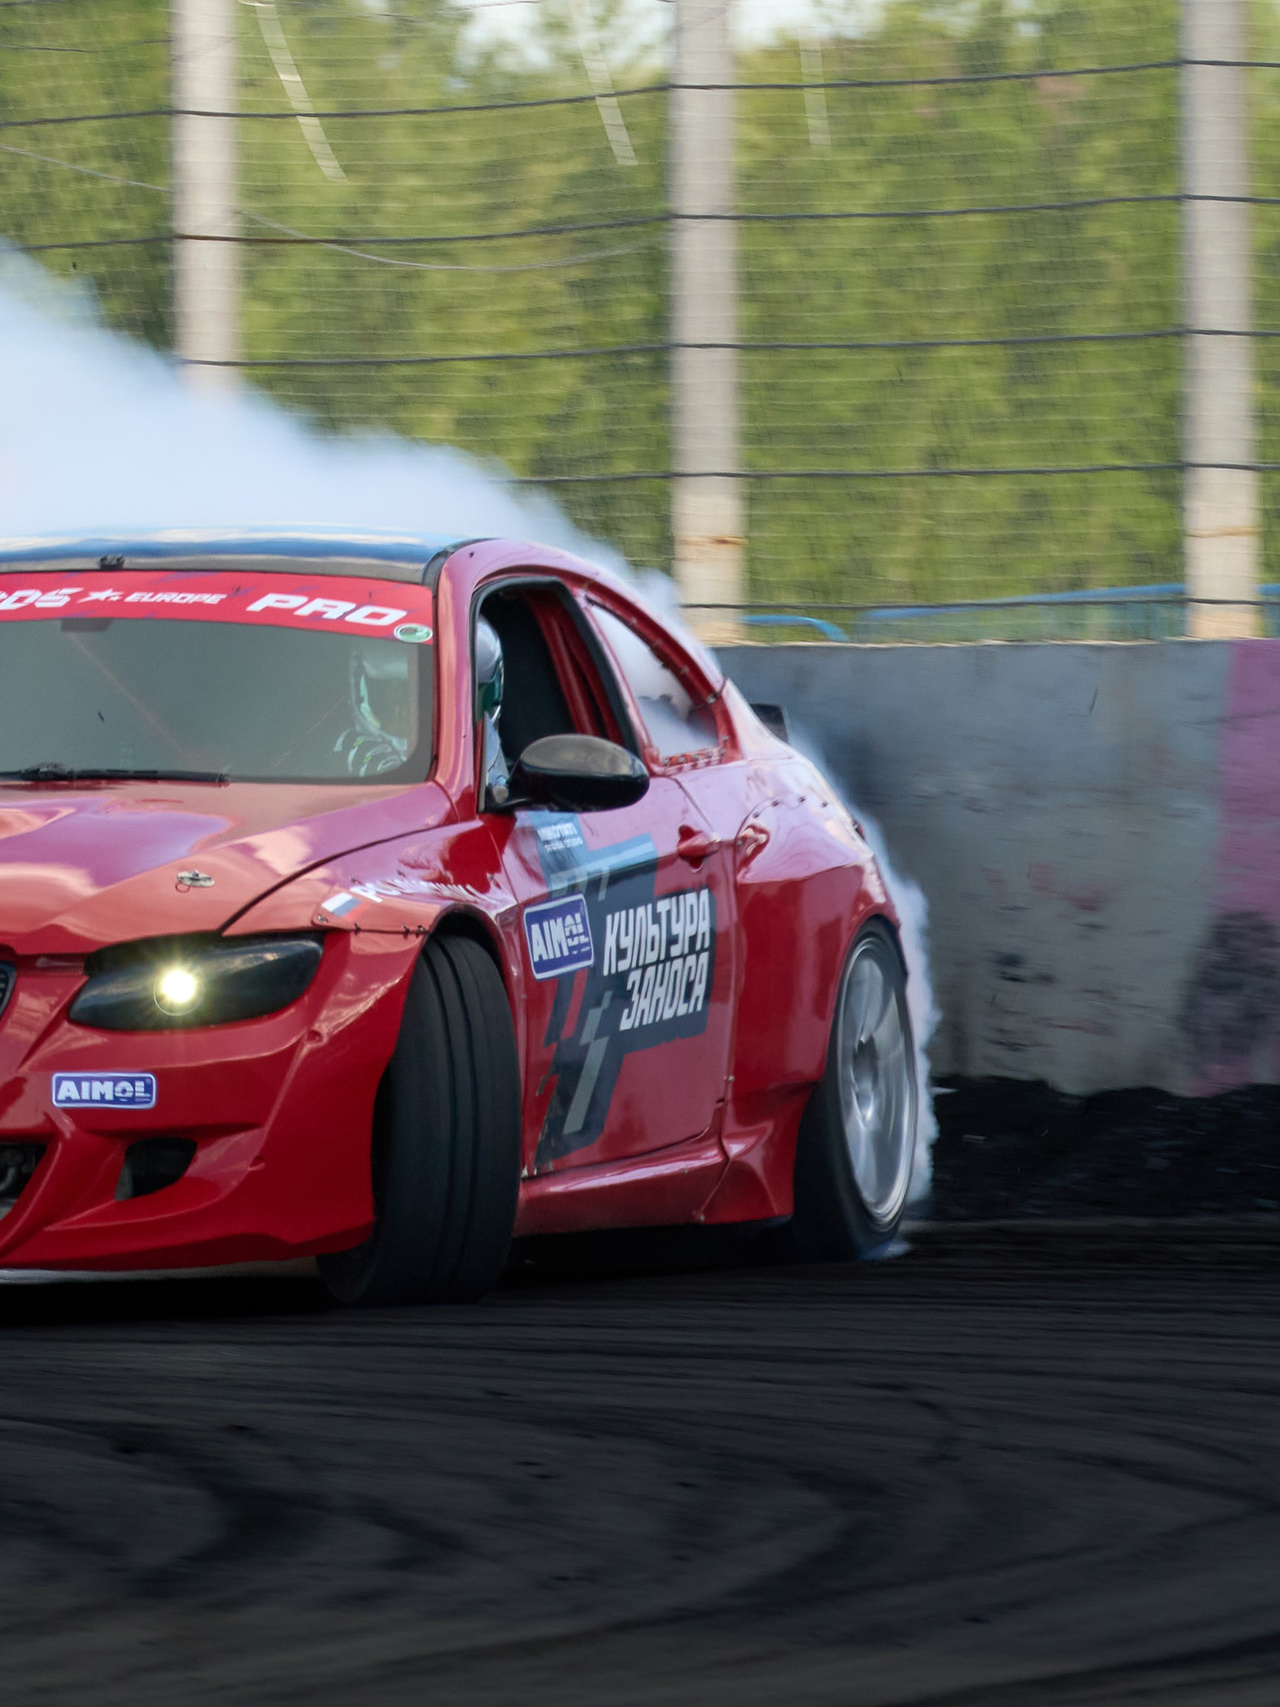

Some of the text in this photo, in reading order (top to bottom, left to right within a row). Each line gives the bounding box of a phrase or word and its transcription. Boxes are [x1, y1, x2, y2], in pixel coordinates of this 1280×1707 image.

[124, 592, 227, 604] EUROPE
[246, 593, 408, 626] PRO
[531, 912, 590, 962] AIMOL
[603, 888, 711, 977] КУЛЬТУРА
[619, 951, 710, 1032] ЗАНОСА
[57, 1080, 151, 1101] AIMOL
